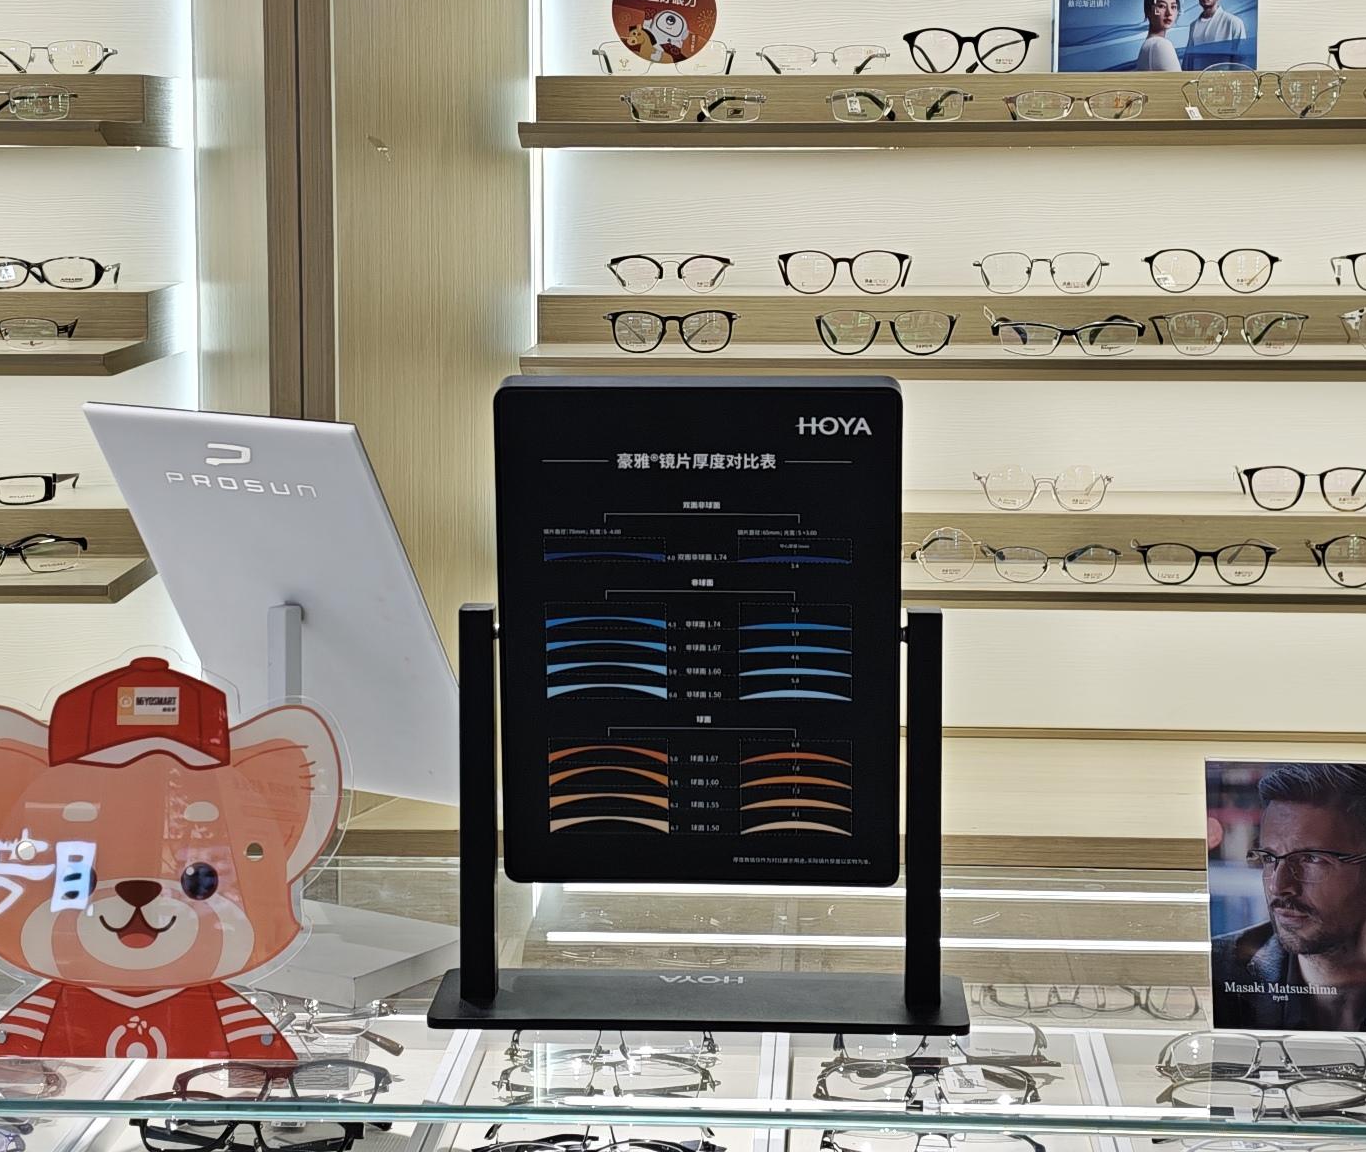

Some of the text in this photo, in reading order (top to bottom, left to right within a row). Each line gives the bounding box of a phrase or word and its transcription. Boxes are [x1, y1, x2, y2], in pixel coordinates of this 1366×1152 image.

[796, 417, 872, 436] HOYA
[616, 453, 777, 470] 豪雅®镜片厚度对比表
[166, 472, 317, 497] PROSUN
[659, 975, 744, 984] HOYA
[1224, 982, 1338, 995] Masaki Matsushima
